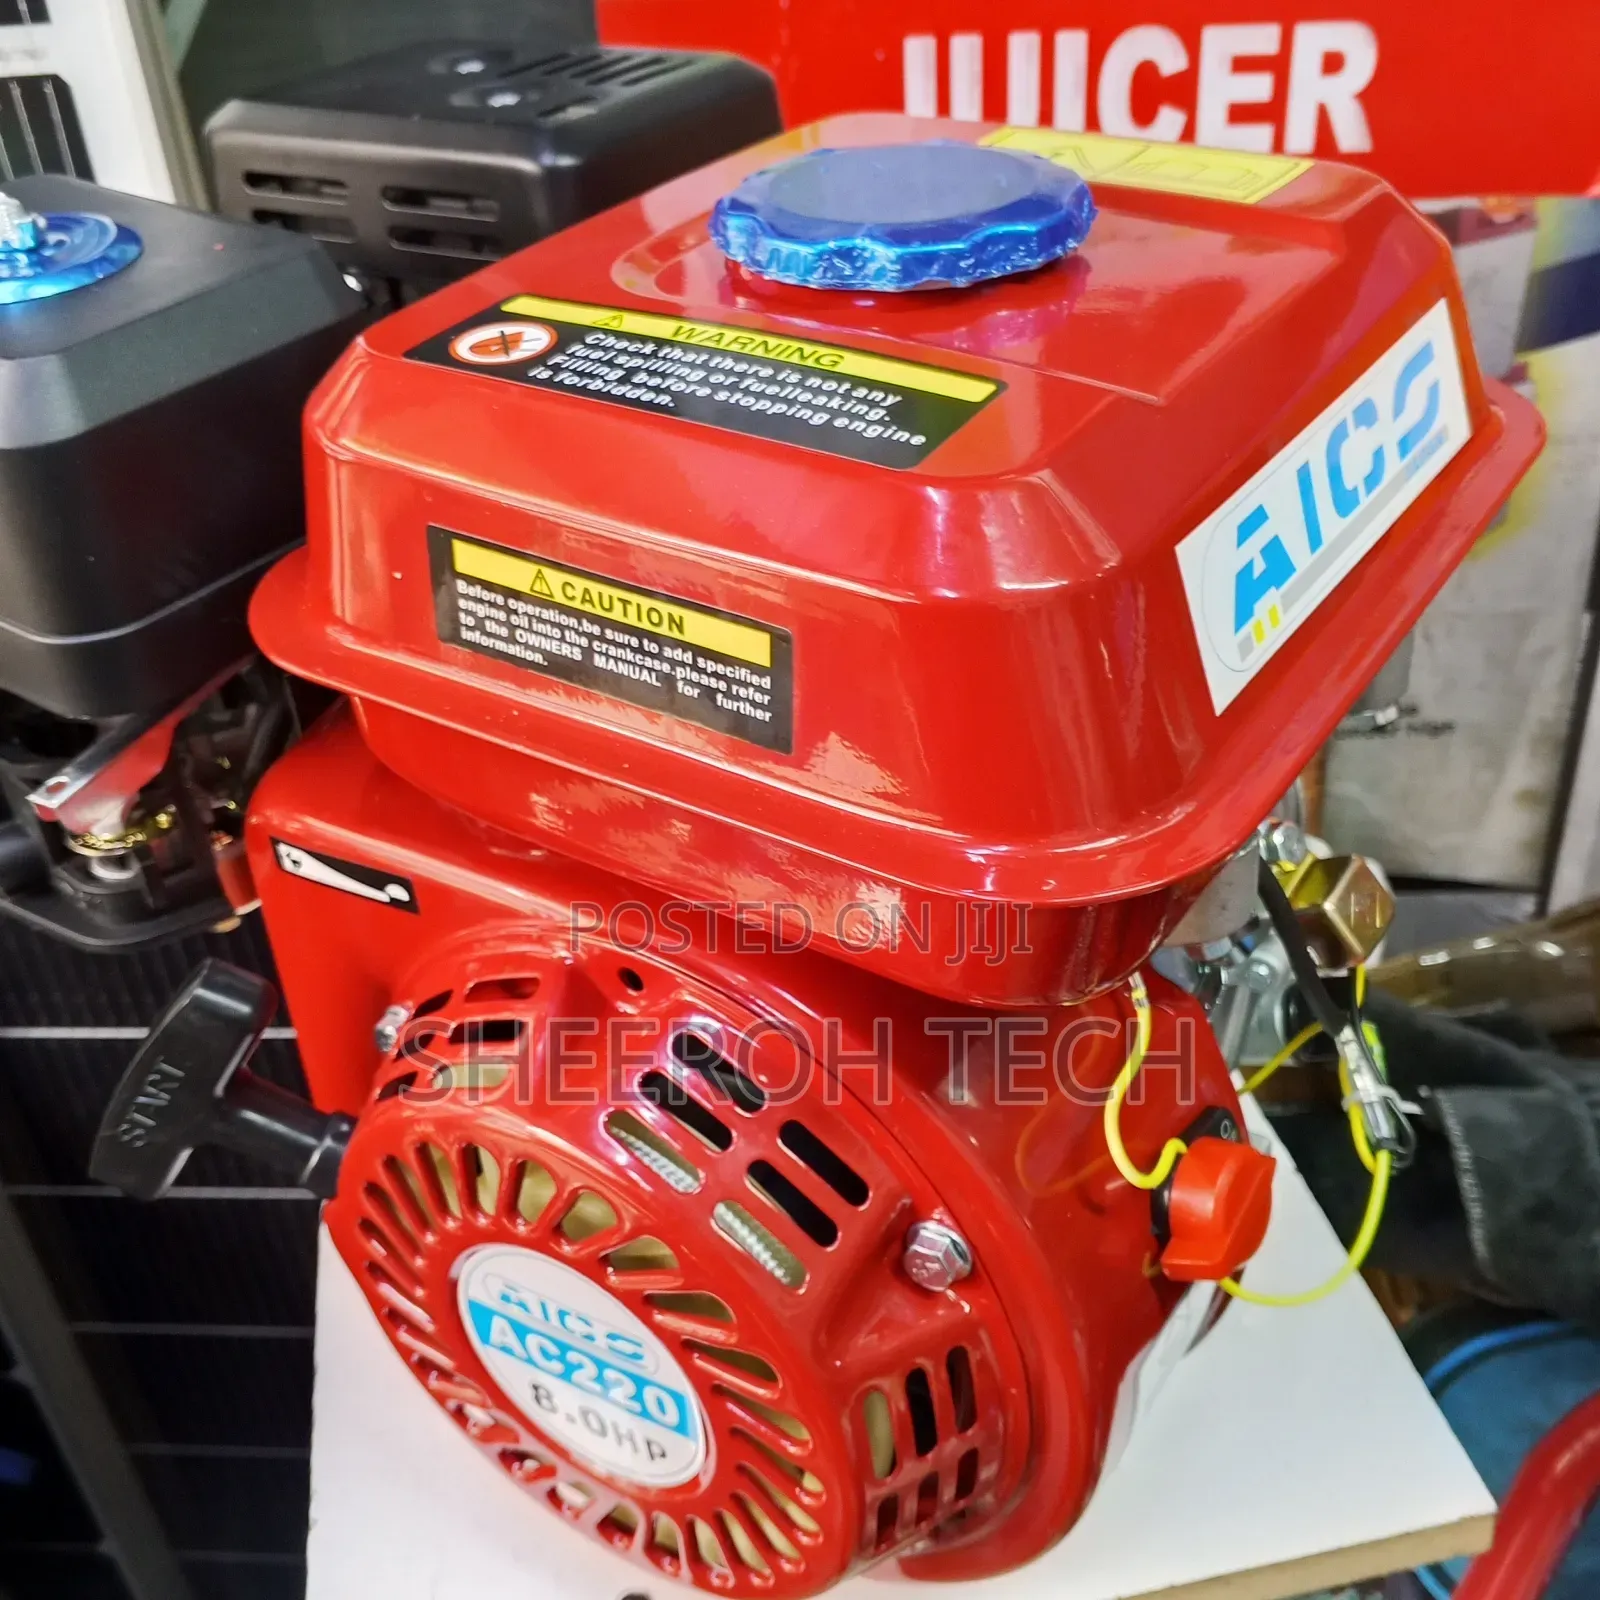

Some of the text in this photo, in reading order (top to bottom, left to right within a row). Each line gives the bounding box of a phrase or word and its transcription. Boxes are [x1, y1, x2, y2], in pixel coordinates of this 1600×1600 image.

[565, 343, 616, 362] fuel
[613, 350, 707, 382] spilling
[709, 371, 739, 386] or
[584, 332, 903, 407] Check that there is not any
[671, 324, 845, 369] WARNING
[527, 365, 676, 408] is forbidden.
[547, 354, 927, 446] Filling before stopping engine
[455, 579, 771, 690] Before operation,be sure to add specified
[460, 626, 549, 666] information.
[561, 581, 685, 636] CAUTION
[458, 599, 772, 706] engine oil into the crankcase.please refer
[458, 611, 773, 723] to the OWNERS MANUAL for further
[488, 1314, 680, 1428] AC220
[531, 1381, 668, 1462] 8.0HP
